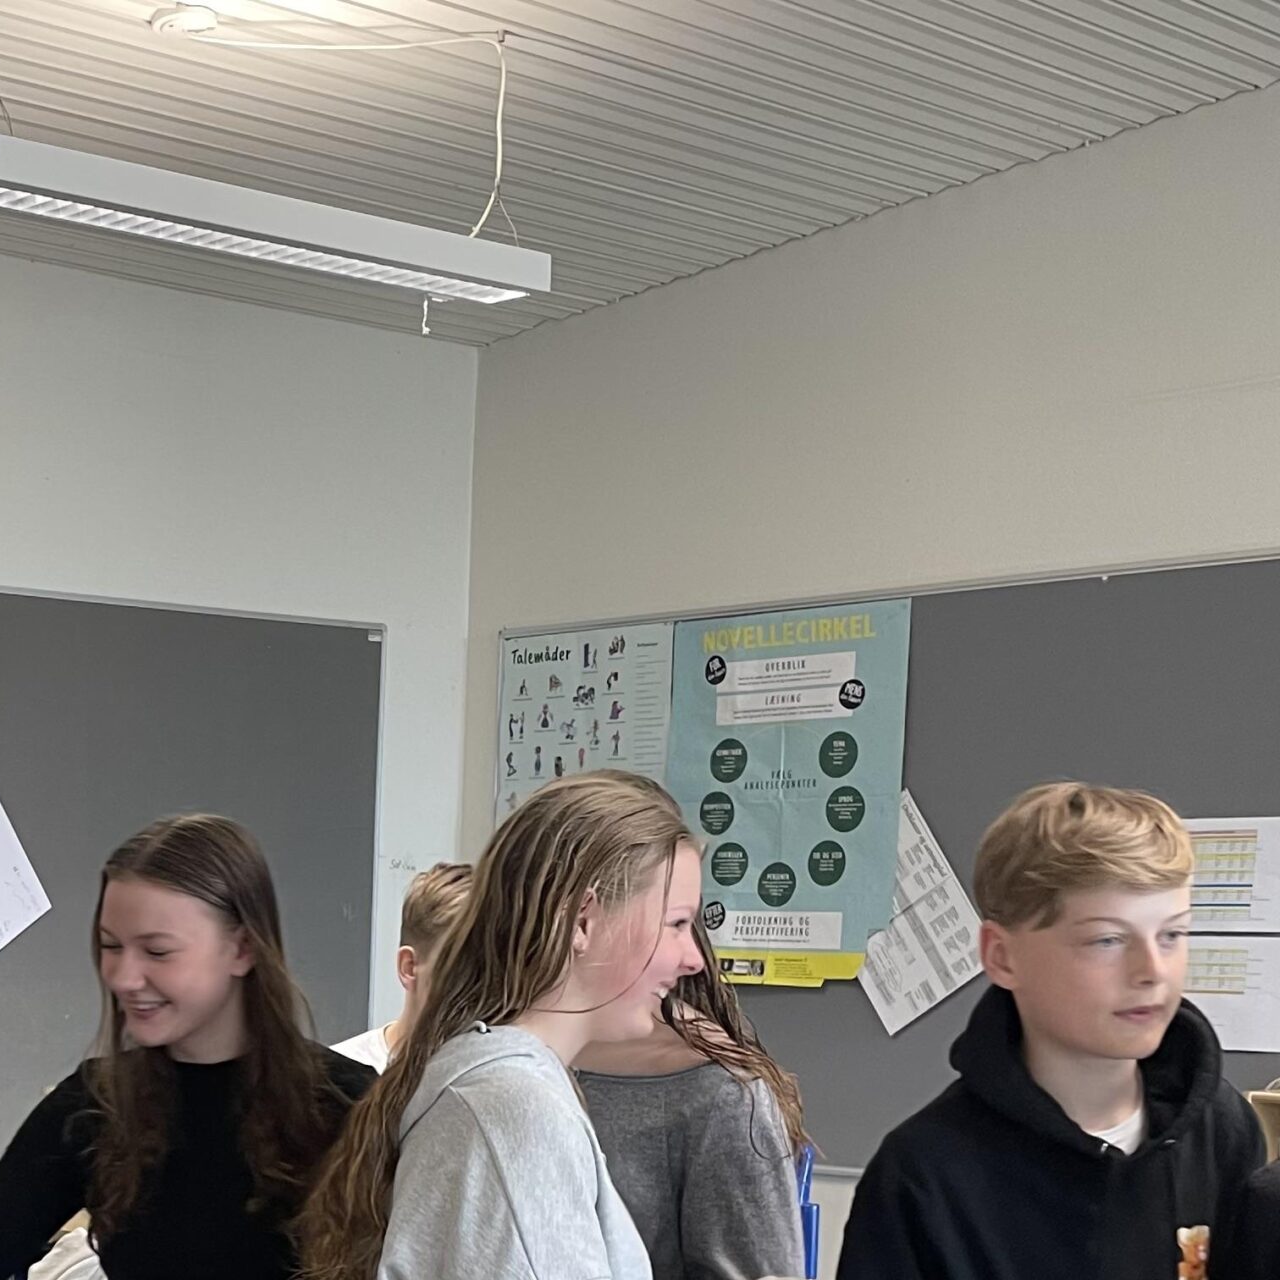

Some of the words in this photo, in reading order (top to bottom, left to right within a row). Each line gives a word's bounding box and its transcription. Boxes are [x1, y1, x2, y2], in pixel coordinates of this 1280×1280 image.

[702, 614, 877, 653] NOVELLECIRKEL
[511, 644, 571, 665] Talemåder
[765, 659, 806, 673] OVERBLIK
[844, 682, 864, 697] MENS
[765, 693, 803, 706] LÆSNING
[744, 778, 817, 790] ANALYSEPUNKTER
[735, 915, 794, 926] FORTOLKNING
[798, 916, 810, 926] OG
[734, 926, 810, 937] PERSPEKTIVERING
